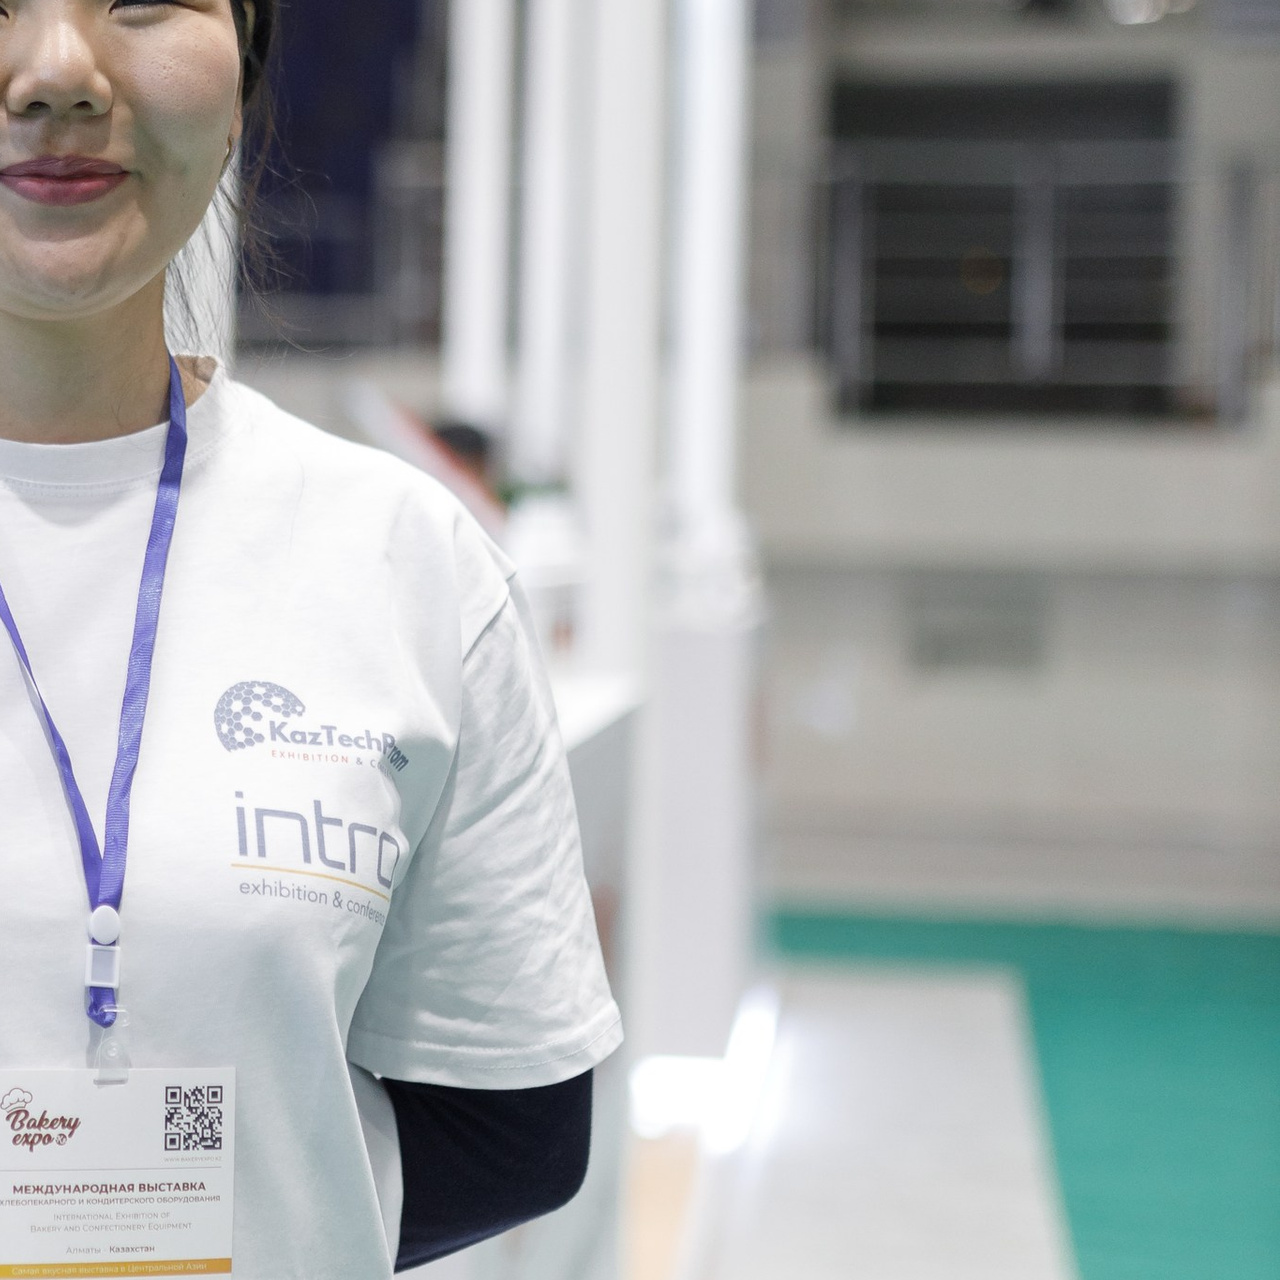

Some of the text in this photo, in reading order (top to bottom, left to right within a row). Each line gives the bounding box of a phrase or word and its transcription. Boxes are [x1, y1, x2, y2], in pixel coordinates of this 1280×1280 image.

[269, 720, 410, 772] KazTechProm
[271, 749, 363, 766] EXHIBITION &
[234, 791, 400, 889] intro
[239, 878, 327, 905] exhibition
[332, 890, 343, 909] &
[5, 1109, 81, 1138] Bakery
[11, 1133, 55, 1152] expo
[12, 1181, 206, 1195] МЕЖДУНАРОДНАЯ ВЫСТАВКА
[0, 1198, 77, 1207] ХЛЕБОПЕКАРНОГО
[86, 1197, 155, 1206] КОНДИТЕРСКОГО
[156, 1195, 221, 1204] ОБОРУДОВАНИЯ
[66, 1246, 101, 1255] Алматы
[109, 1245, 155, 1254] Казахстан
